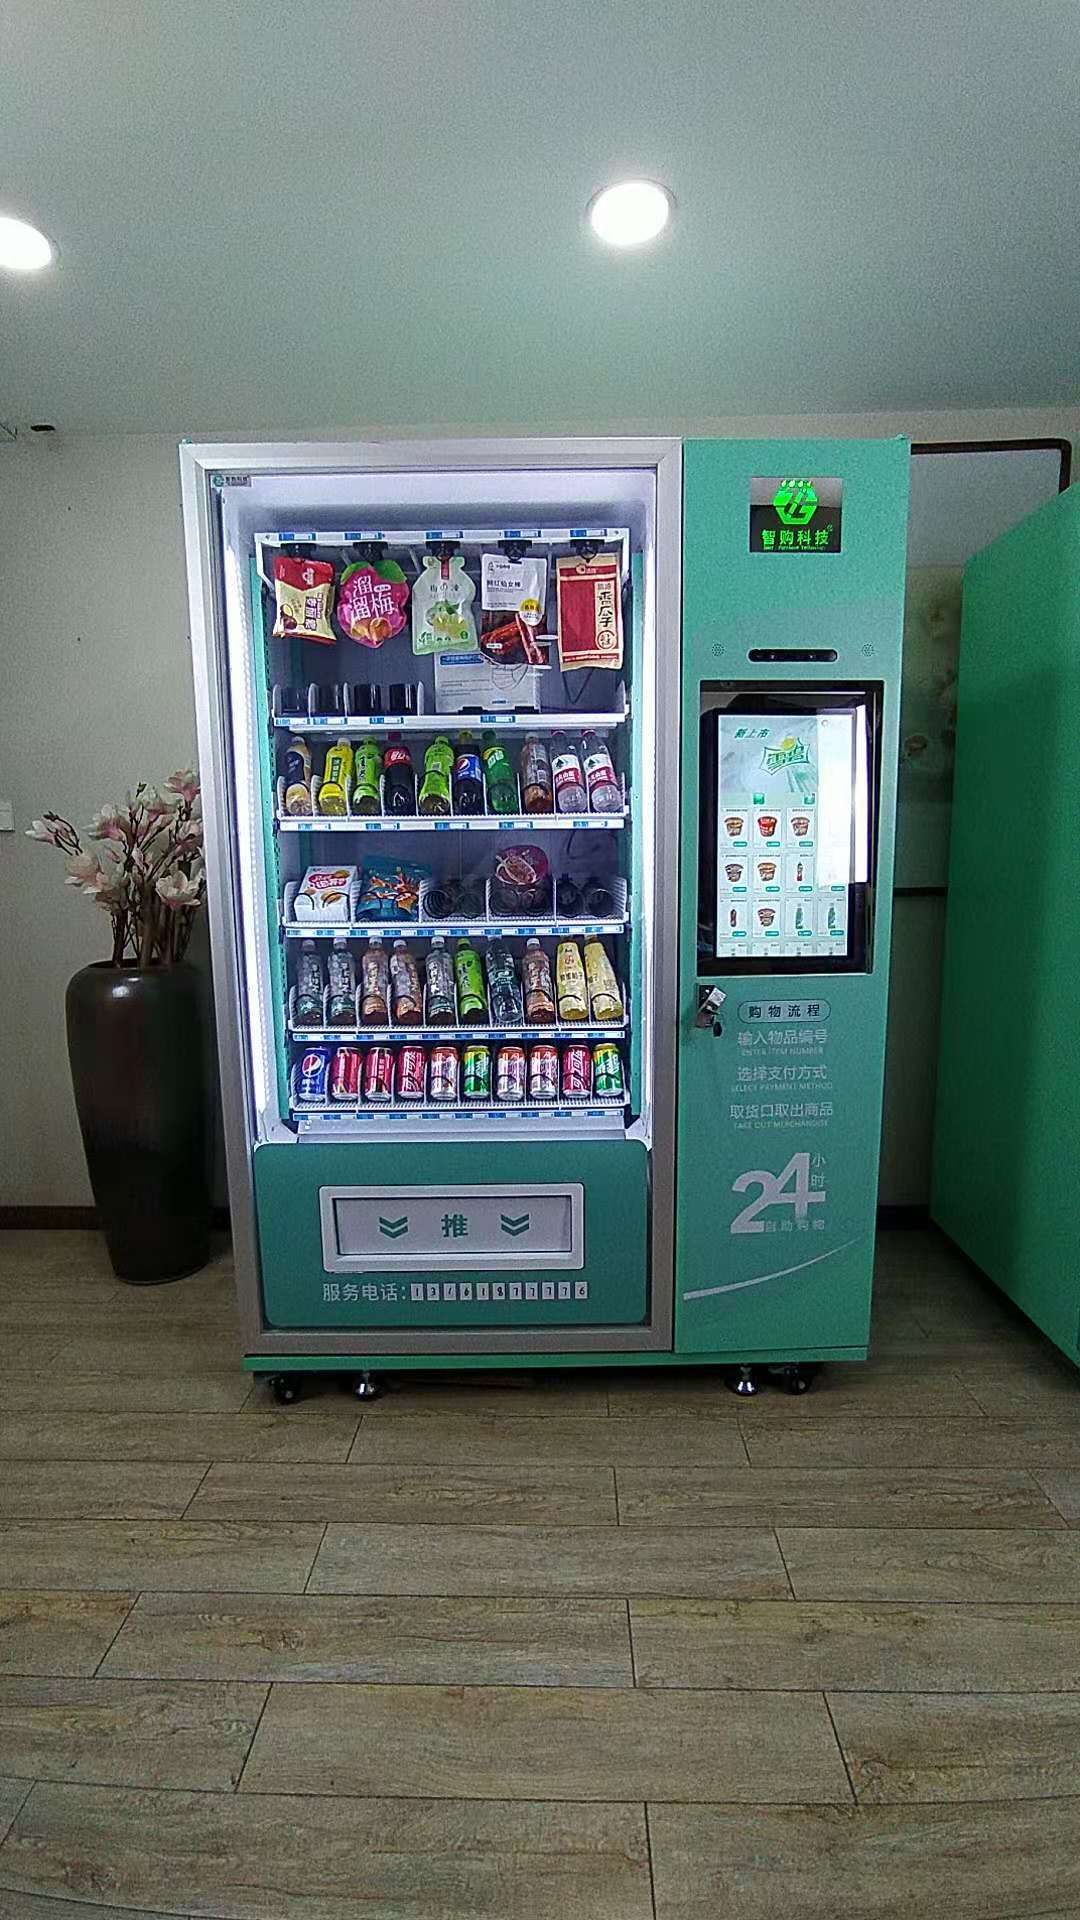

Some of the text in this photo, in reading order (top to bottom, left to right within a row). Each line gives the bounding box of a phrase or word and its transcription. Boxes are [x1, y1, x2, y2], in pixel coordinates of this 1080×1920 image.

[762, 529, 829, 545] 智购科技
[748, 1004, 821, 1018] 购物流程
[737, 1029, 829, 1046] 输入物品编号
[737, 1064, 828, 1082] 选择支付方式
[730, 1102, 833, 1119] 取货口取出商品
[811, 1152, 826, 1188] 小时
[730, 1152, 826, 1234] 24
[440, 1213, 469, 1239] 推
